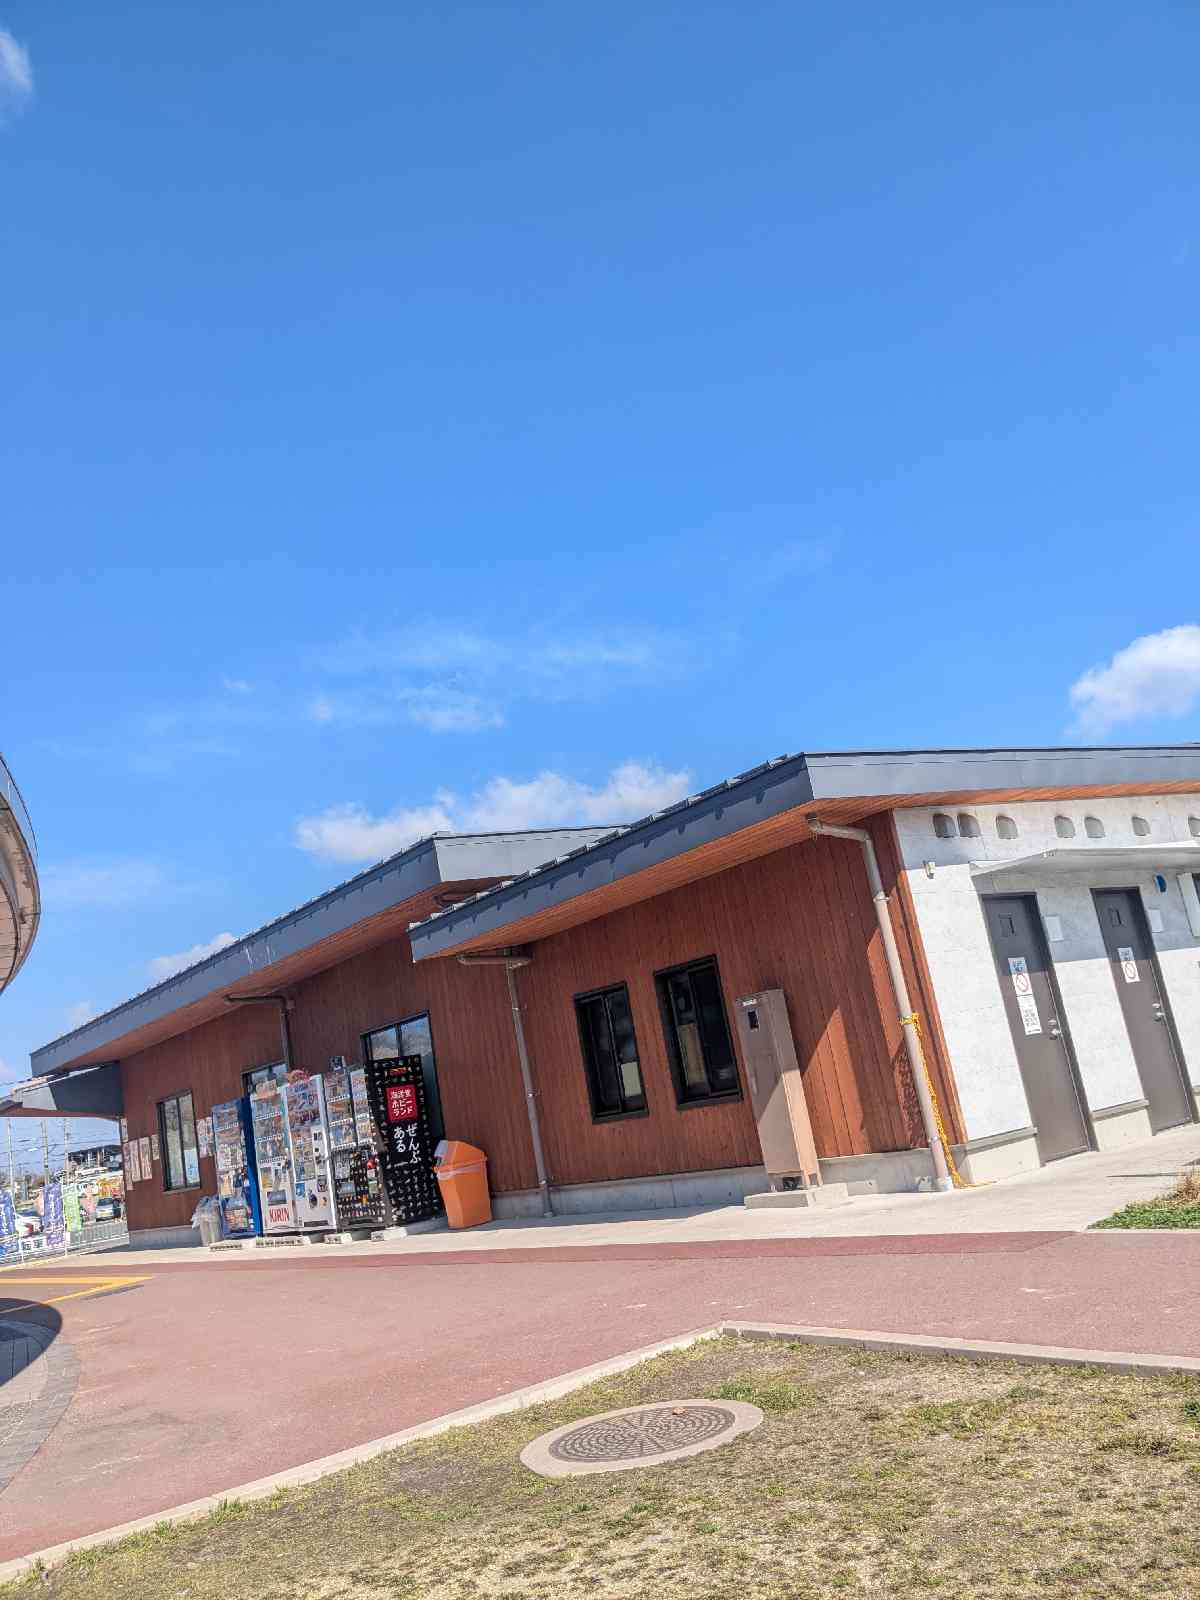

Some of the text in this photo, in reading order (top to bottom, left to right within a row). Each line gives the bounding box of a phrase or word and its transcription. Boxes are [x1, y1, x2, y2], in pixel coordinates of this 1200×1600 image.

[392, 1099, 413, 1109] ホビー
[393, 1107, 414, 1117] ランド
[393, 1126, 406, 1153] ある
[406, 1123, 421, 1164] ぜんぶ
[269, 1207, 289, 1223] KIRIN
